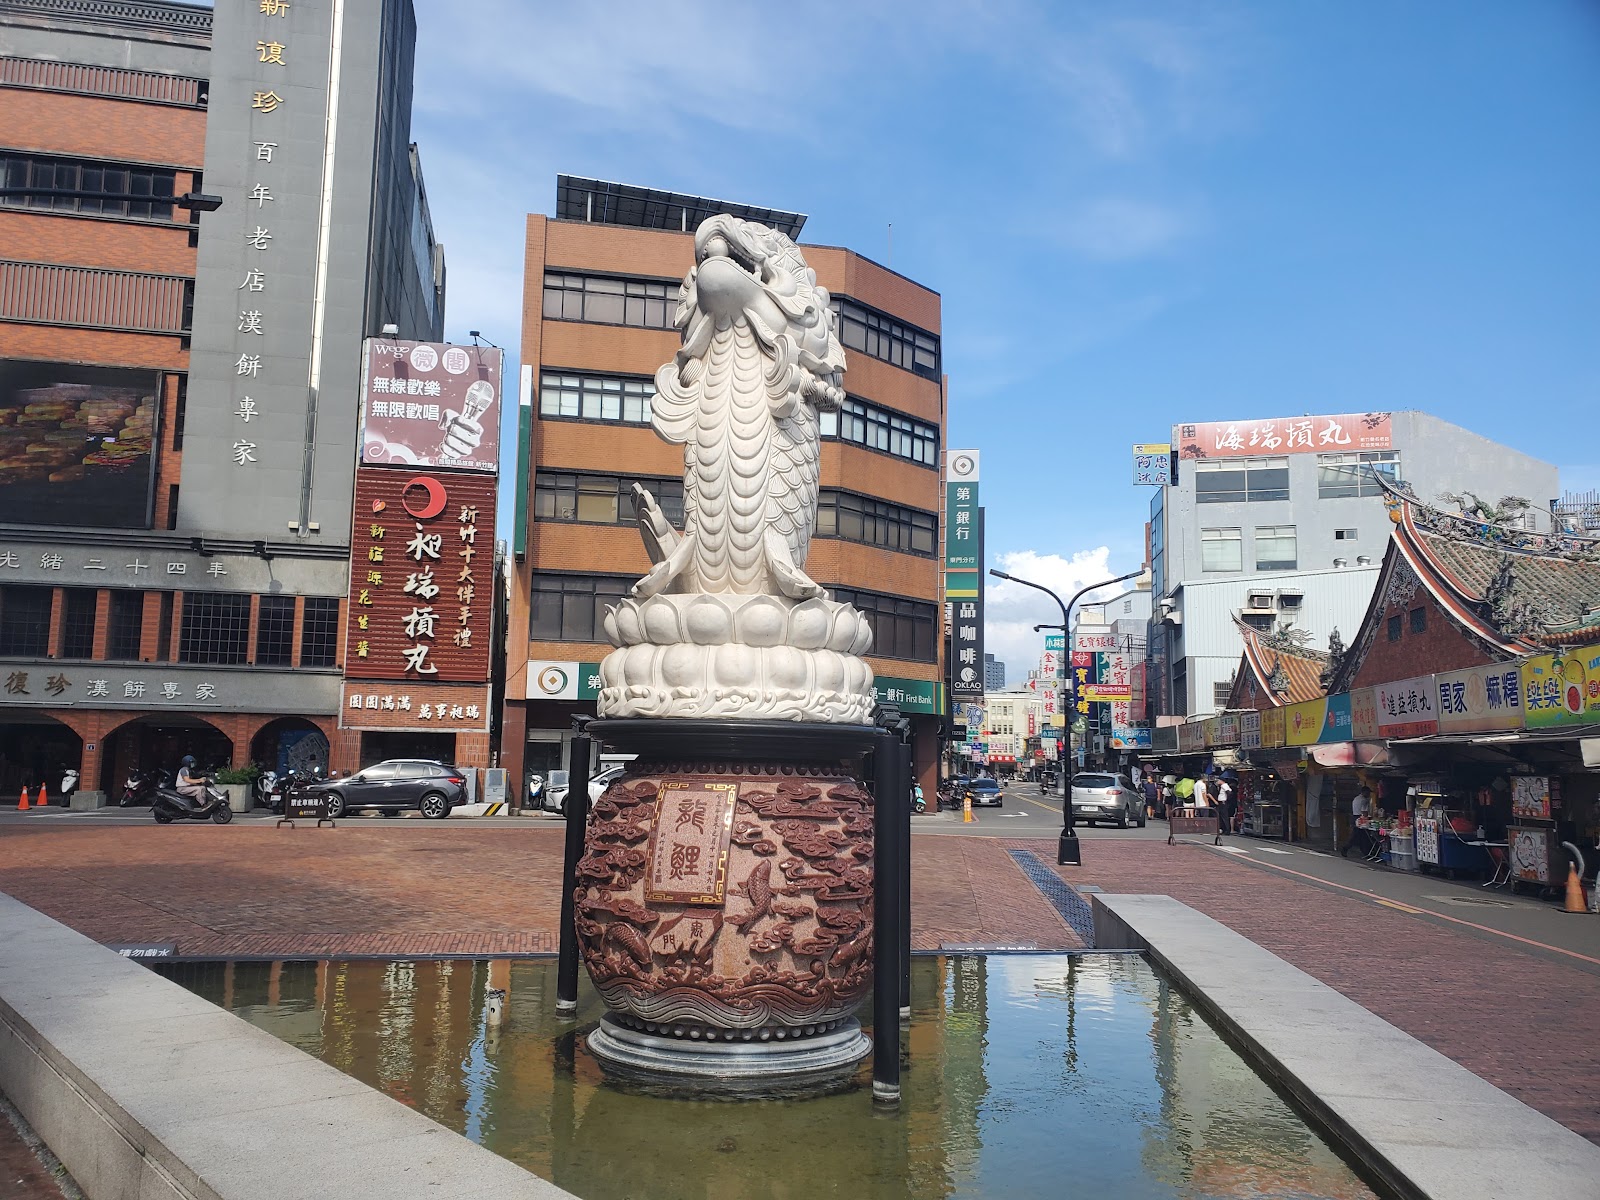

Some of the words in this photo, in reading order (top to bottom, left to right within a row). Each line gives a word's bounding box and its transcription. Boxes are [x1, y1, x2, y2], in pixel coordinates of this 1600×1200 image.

[412, 346, 469, 374] 薇閣
[373, 376, 441, 397] 無線歡樂
[371, 400, 440, 422] 無限歡唱
[1135, 455, 1168, 469] 阿忠
[955, 487, 971, 541] 第一銀行
[0, 550, 228, 578] 光緒二十四年
[452, 504, 480, 648] 新竹十大伴手禮
[959, 602, 977, 664] 品咖啡
[1077, 636, 1118, 648] 元寶銀樓
[869, 686, 905, 702] 第一銀行
[905, 694, 918, 704] First
[918, 695, 932, 705] Bank
[1440, 681, 1468, 714] 周家
[119, 948, 170, 957] 請勿戲水
